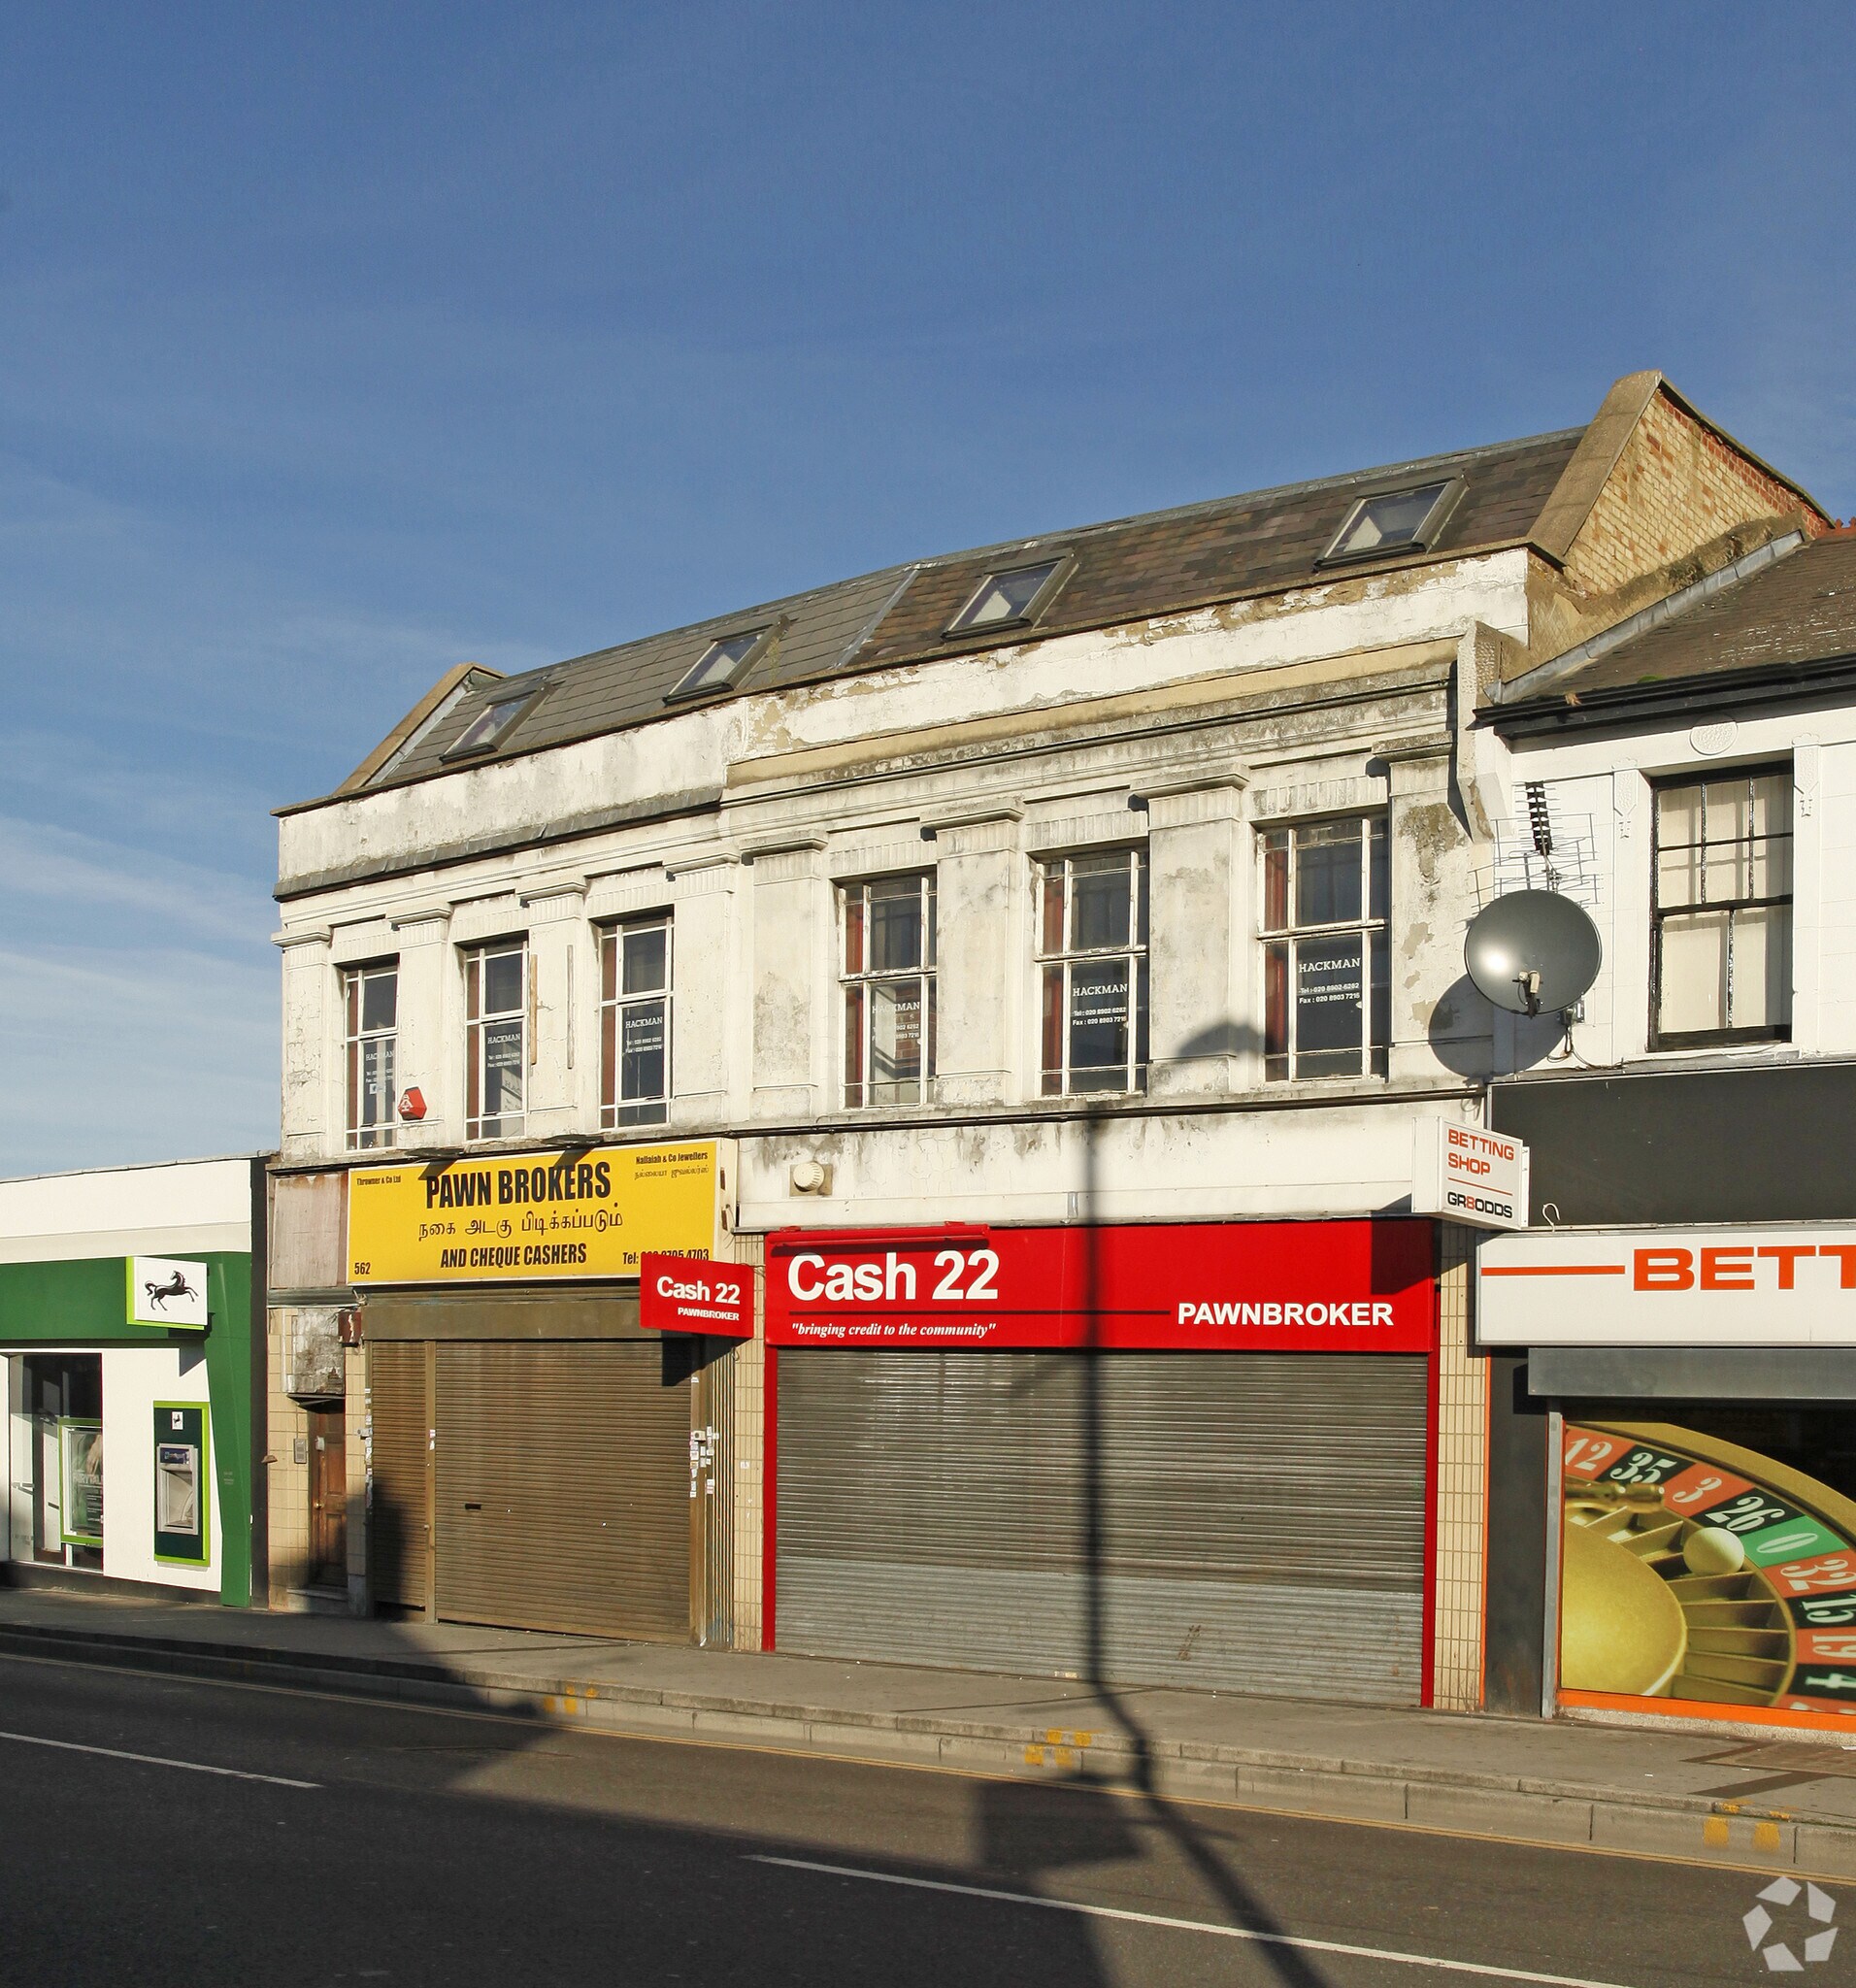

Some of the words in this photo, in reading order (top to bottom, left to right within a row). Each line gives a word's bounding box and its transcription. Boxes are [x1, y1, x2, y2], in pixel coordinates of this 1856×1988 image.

[1299, 958, 1360, 974] HACKMAN
[1073, 983, 1128, 997] HACKMAN
[625, 1016, 663, 1029] HACKMAN
[487, 1033, 521, 1044] HACKMAN
[663, 1154, 668, 1163] &
[668, 1153, 678, 1163] Co
[678, 1151, 709, 1162] Jewellers
[1448, 1129, 1514, 1161] BETTING
[1447, 1152, 1491, 1176] SHOP
[385, 1176, 393, 1184] Co
[393, 1175, 402, 1183] Ltd
[426, 1171, 491, 1209] PAWN
[498, 1161, 612, 1205] BROKERS
[1447, 1191, 1513, 1219] GR8ODDS
[418, 1222, 456, 1242] நகை
[464, 1219, 513, 1239] அடகு
[521, 1202, 624, 1236] பிடிக்கப்படும்
[440, 1248, 467, 1269] AND
[470, 1246, 521, 1268] CHEQUE
[523, 1242, 587, 1266] CASHERS
[622, 1251, 640, 1265] Tel:
[354, 1262, 371, 1276] 562
[787, 1251, 917, 1302] Cash
[931, 1248, 1000, 1301] 22
[656, 1275, 711, 1302] Cash
[714, 1282, 741, 1305] 22
[678, 1307, 740, 1321] PAWNBROKER
[1177, 1303, 1394, 1326] PAWNBROKER
[791, 1322, 845, 1339] "bringing
[847, 1322, 881, 1336] credit
[883, 1324, 896, 1336] to
[898, 1322, 921, 1336] the
[919, 1322, 996, 1339] community"
[1609, 1452, 1678, 1484] 35
[1673, 1476, 1722, 1504] 3
[1705, 1496, 1786, 1532] 26
[1779, 1558, 1856, 1592] 32
